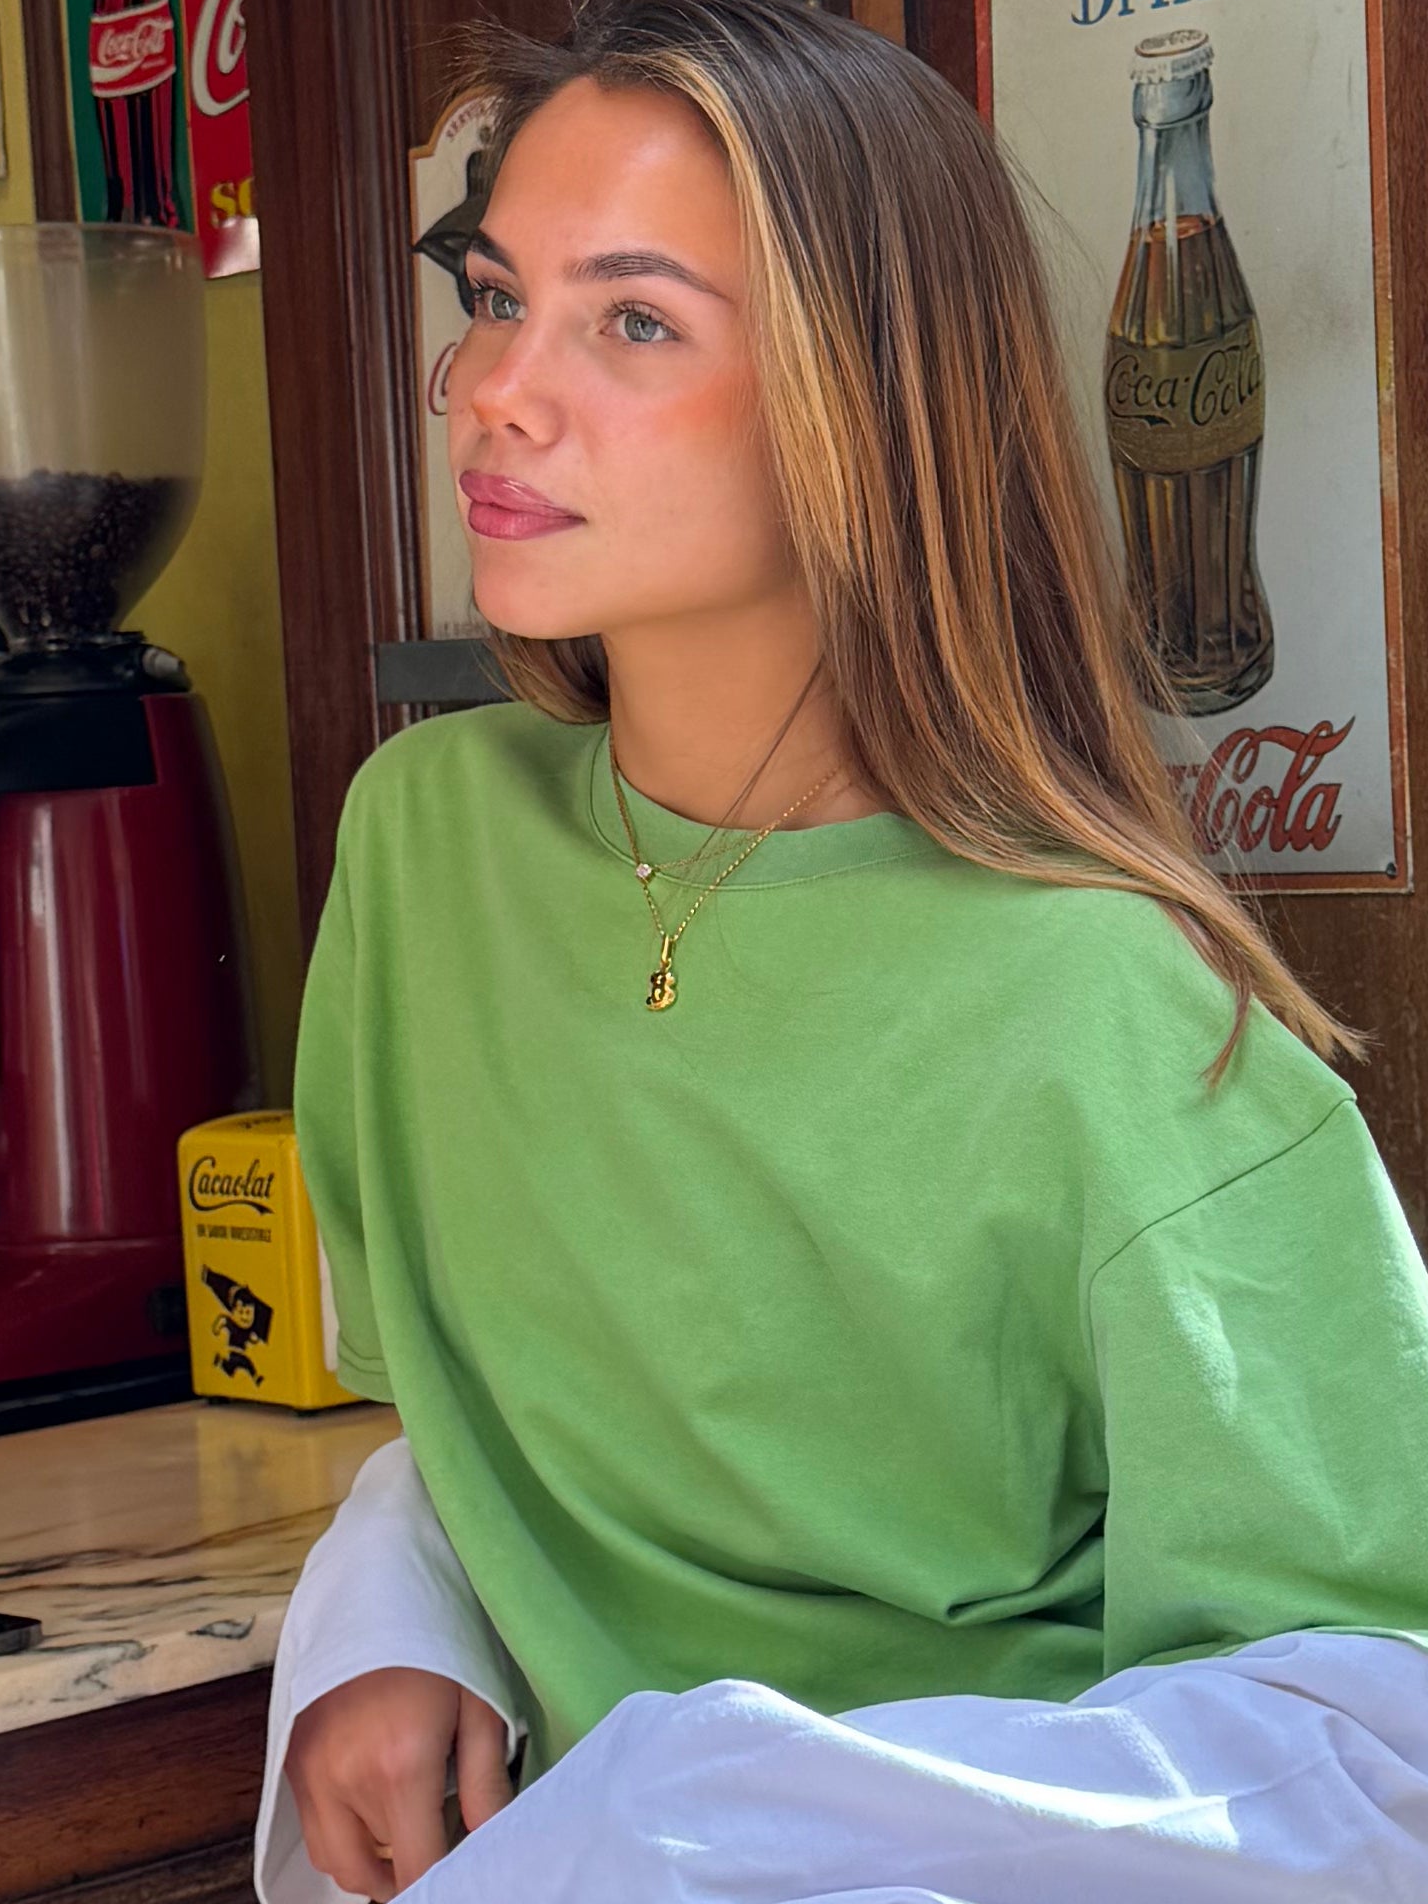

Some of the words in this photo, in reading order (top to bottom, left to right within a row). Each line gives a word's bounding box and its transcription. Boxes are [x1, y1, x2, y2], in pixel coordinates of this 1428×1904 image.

[1106, 340, 1262, 427] Coca-Cola
[1167, 714, 1356, 856] -Cola
[189, 1155, 275, 1215] Cacaolat
